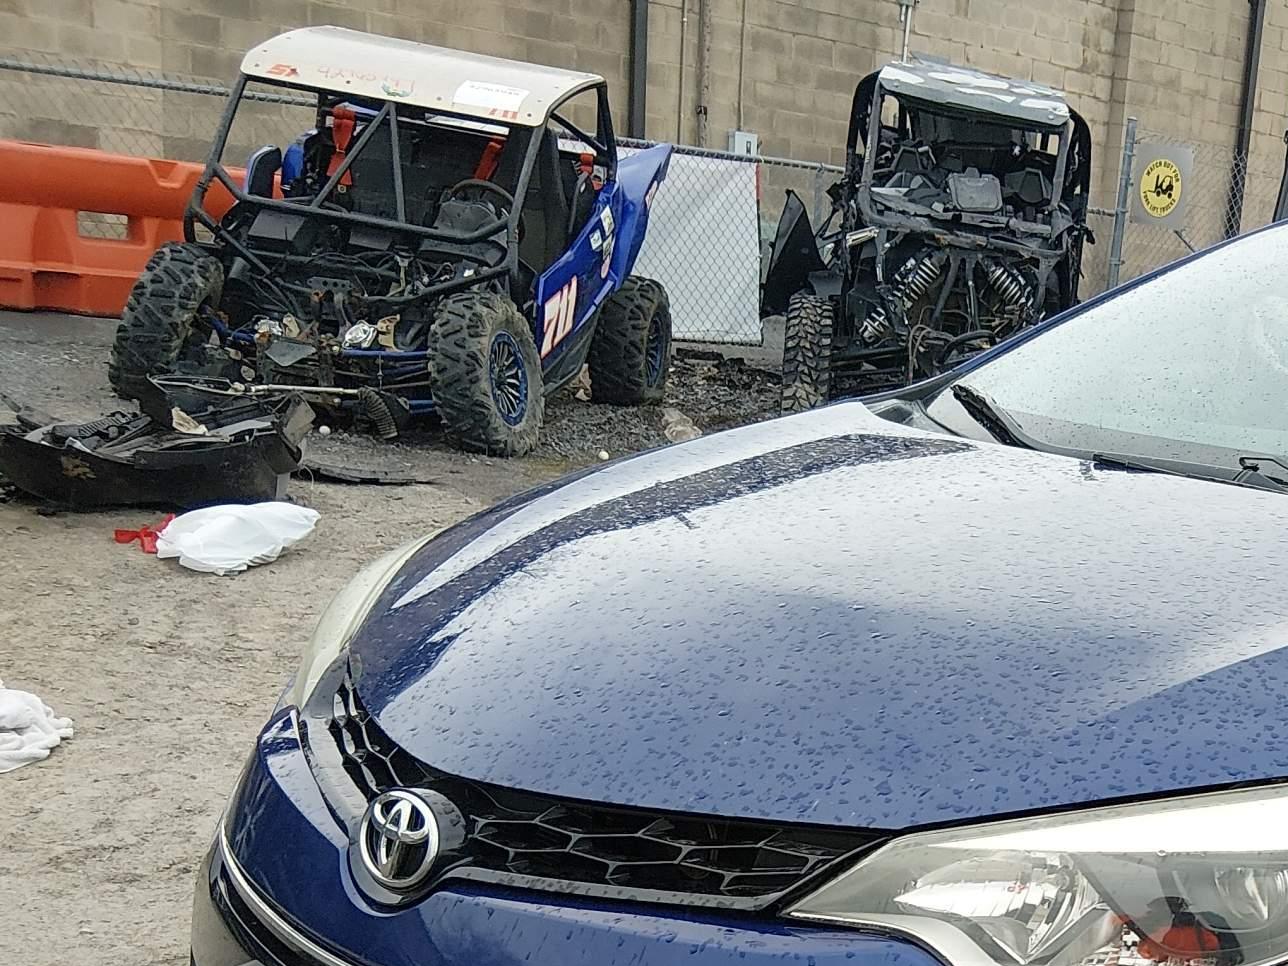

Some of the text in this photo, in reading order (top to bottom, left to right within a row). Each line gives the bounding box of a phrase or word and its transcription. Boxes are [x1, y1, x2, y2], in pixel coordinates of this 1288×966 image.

[1146, 161, 1180, 183] WATCH OUT FOR
[1143, 190, 1151, 206] FORK
[1159, 198, 1176, 214] TRUCKS
[541, 274, 578, 360] 711
